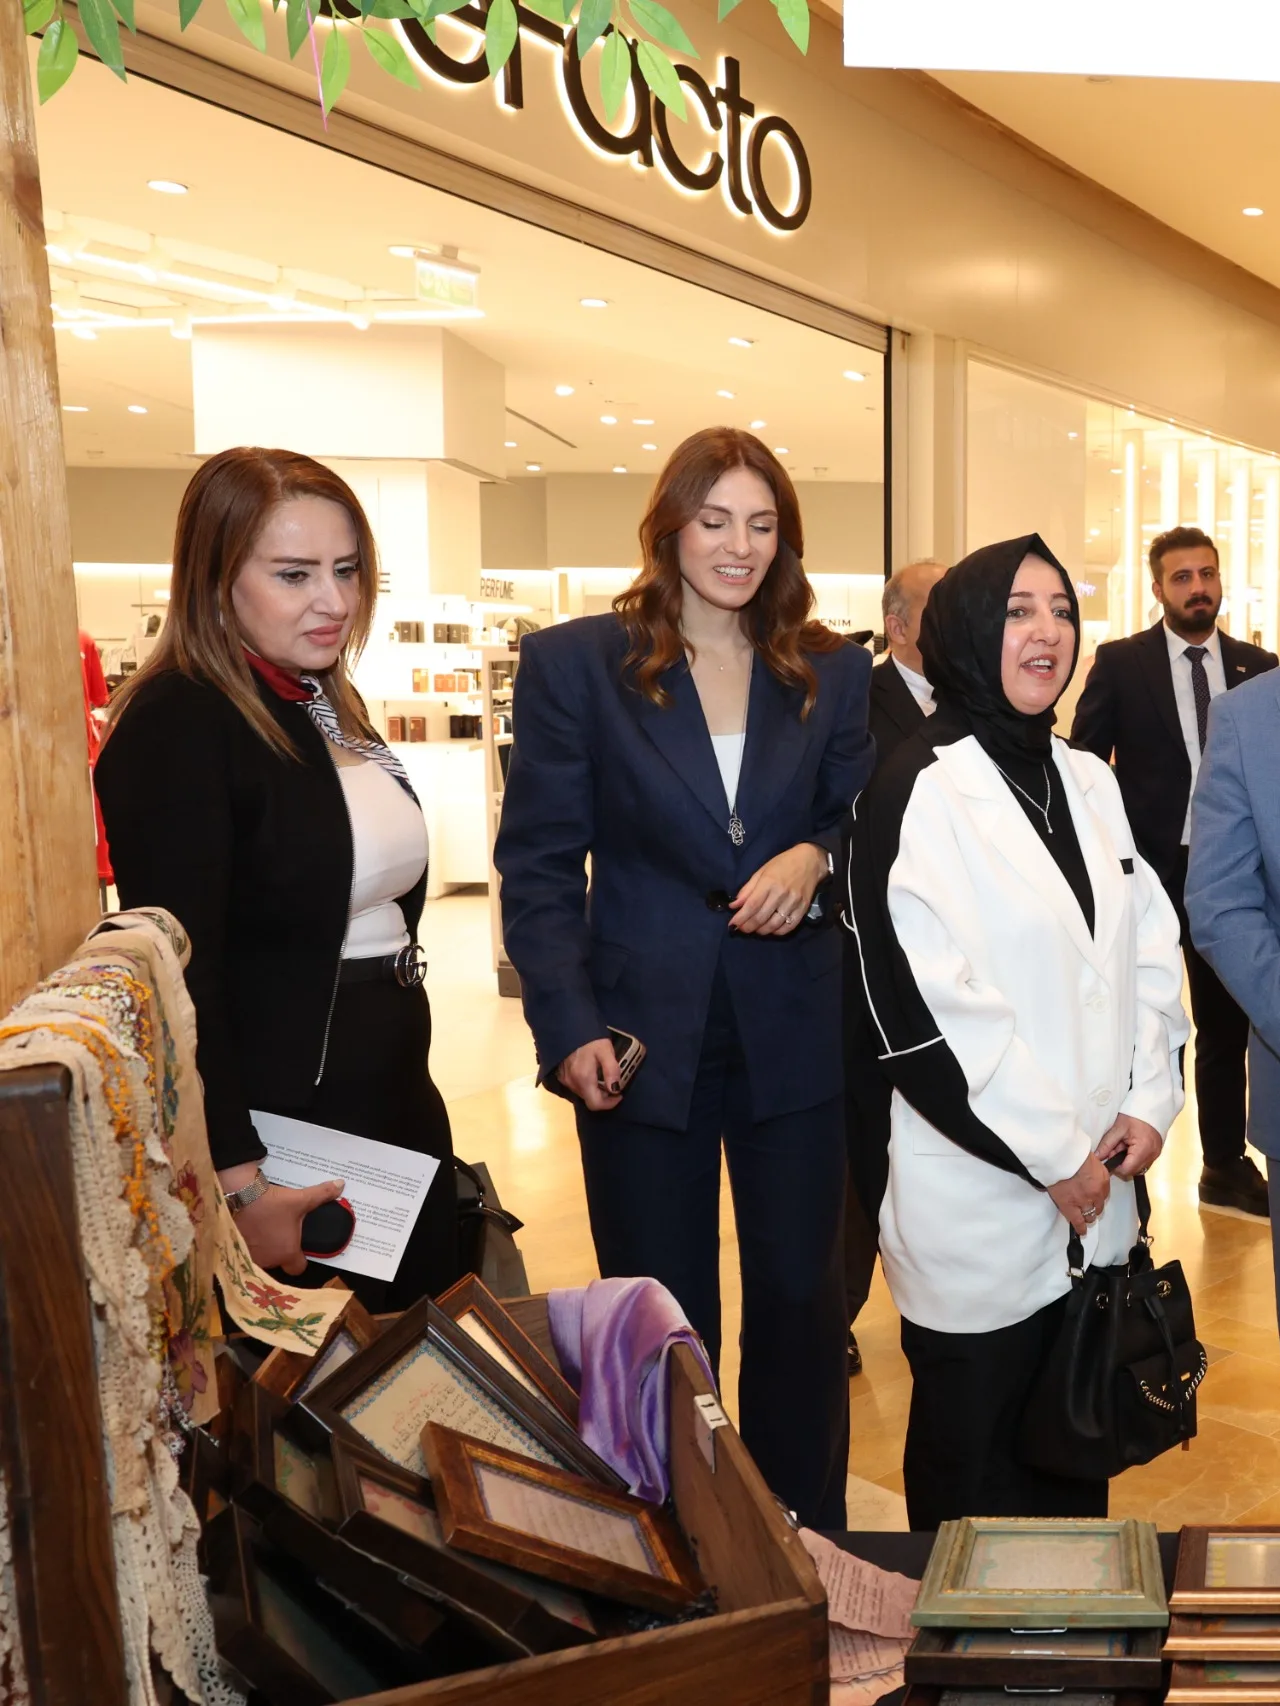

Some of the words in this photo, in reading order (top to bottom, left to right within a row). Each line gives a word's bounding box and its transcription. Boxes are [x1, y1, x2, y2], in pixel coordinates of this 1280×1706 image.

[319, 0, 812, 231] eacto
[479, 577, 515, 600] PERFUME
[820, 618, 852, 628] ENIM
